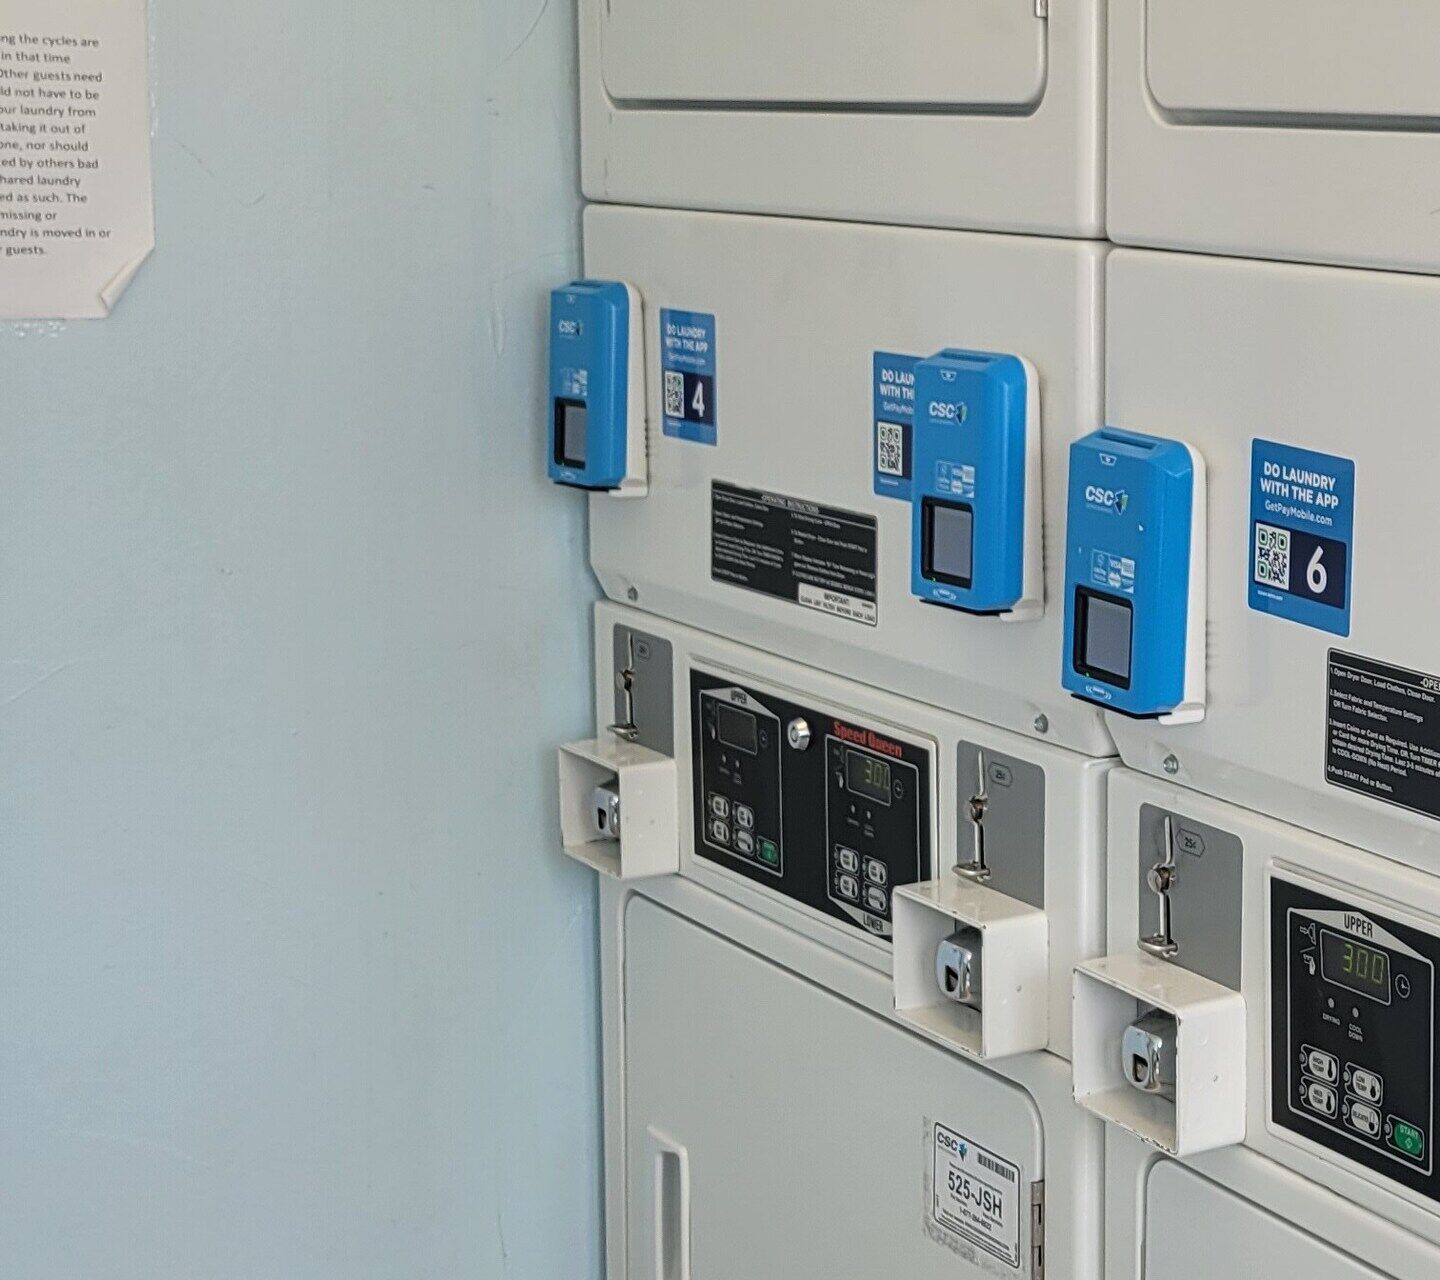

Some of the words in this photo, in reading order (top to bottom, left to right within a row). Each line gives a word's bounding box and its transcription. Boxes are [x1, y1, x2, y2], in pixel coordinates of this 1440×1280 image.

[19, 34, 38, 44] the
[42, 36, 78, 47] cycles
[81, 39, 99, 47] are
[16, 52, 39, 62] that
[44, 54, 70, 64] time
[33, 71, 71, 81] guests
[73, 72, 102, 82] need
[15, 89, 34, 97] not
[39, 88, 65, 98] have
[70, 90, 81, 99] to
[85, 90, 99, 100] be
[20, 105, 64, 118] laundry
[68, 106, 96, 116] from
[51, 124, 69, 134] out
[74, 124, 86, 134] of
[26, 142, 45, 150] nor
[50, 141, 89, 151] should
[19, 158, 33, 169] by
[37, 158, 75, 168] others
[78, 159, 99, 169] bad
[38, 175, 81, 188] laundry
[67, 193, 87, 203] The
[31, 229, 39, 237] is
[43, 228, 82, 238] moved
[85, 228, 95, 237] in
[882, 369, 894, 382] DO
[880, 383, 900, 398] WITH
[692, 380, 705, 418] 4
[929, 401, 955, 418] CSC
[1263, 461, 1280, 477] DO
[1283, 465, 1336, 491] LAUNDRY
[1086, 485, 1113, 505] CSC
[1260, 478, 1289, 497] WITH
[1291, 487, 1313, 504] THE
[1316, 491, 1339, 509] APP
[1265, 499, 1333, 526] GetPayMobile.com
[1307, 545, 1327, 594] 6
[833, 720, 867, 745] Speed
[868, 732, 902, 758] Queen
[1344, 913, 1373, 939] UPPER
[1343, 943, 1386, 984] 300
[937, 1132, 958, 1151] CSC
[948, 1171, 1002, 1218] 525-JSH
